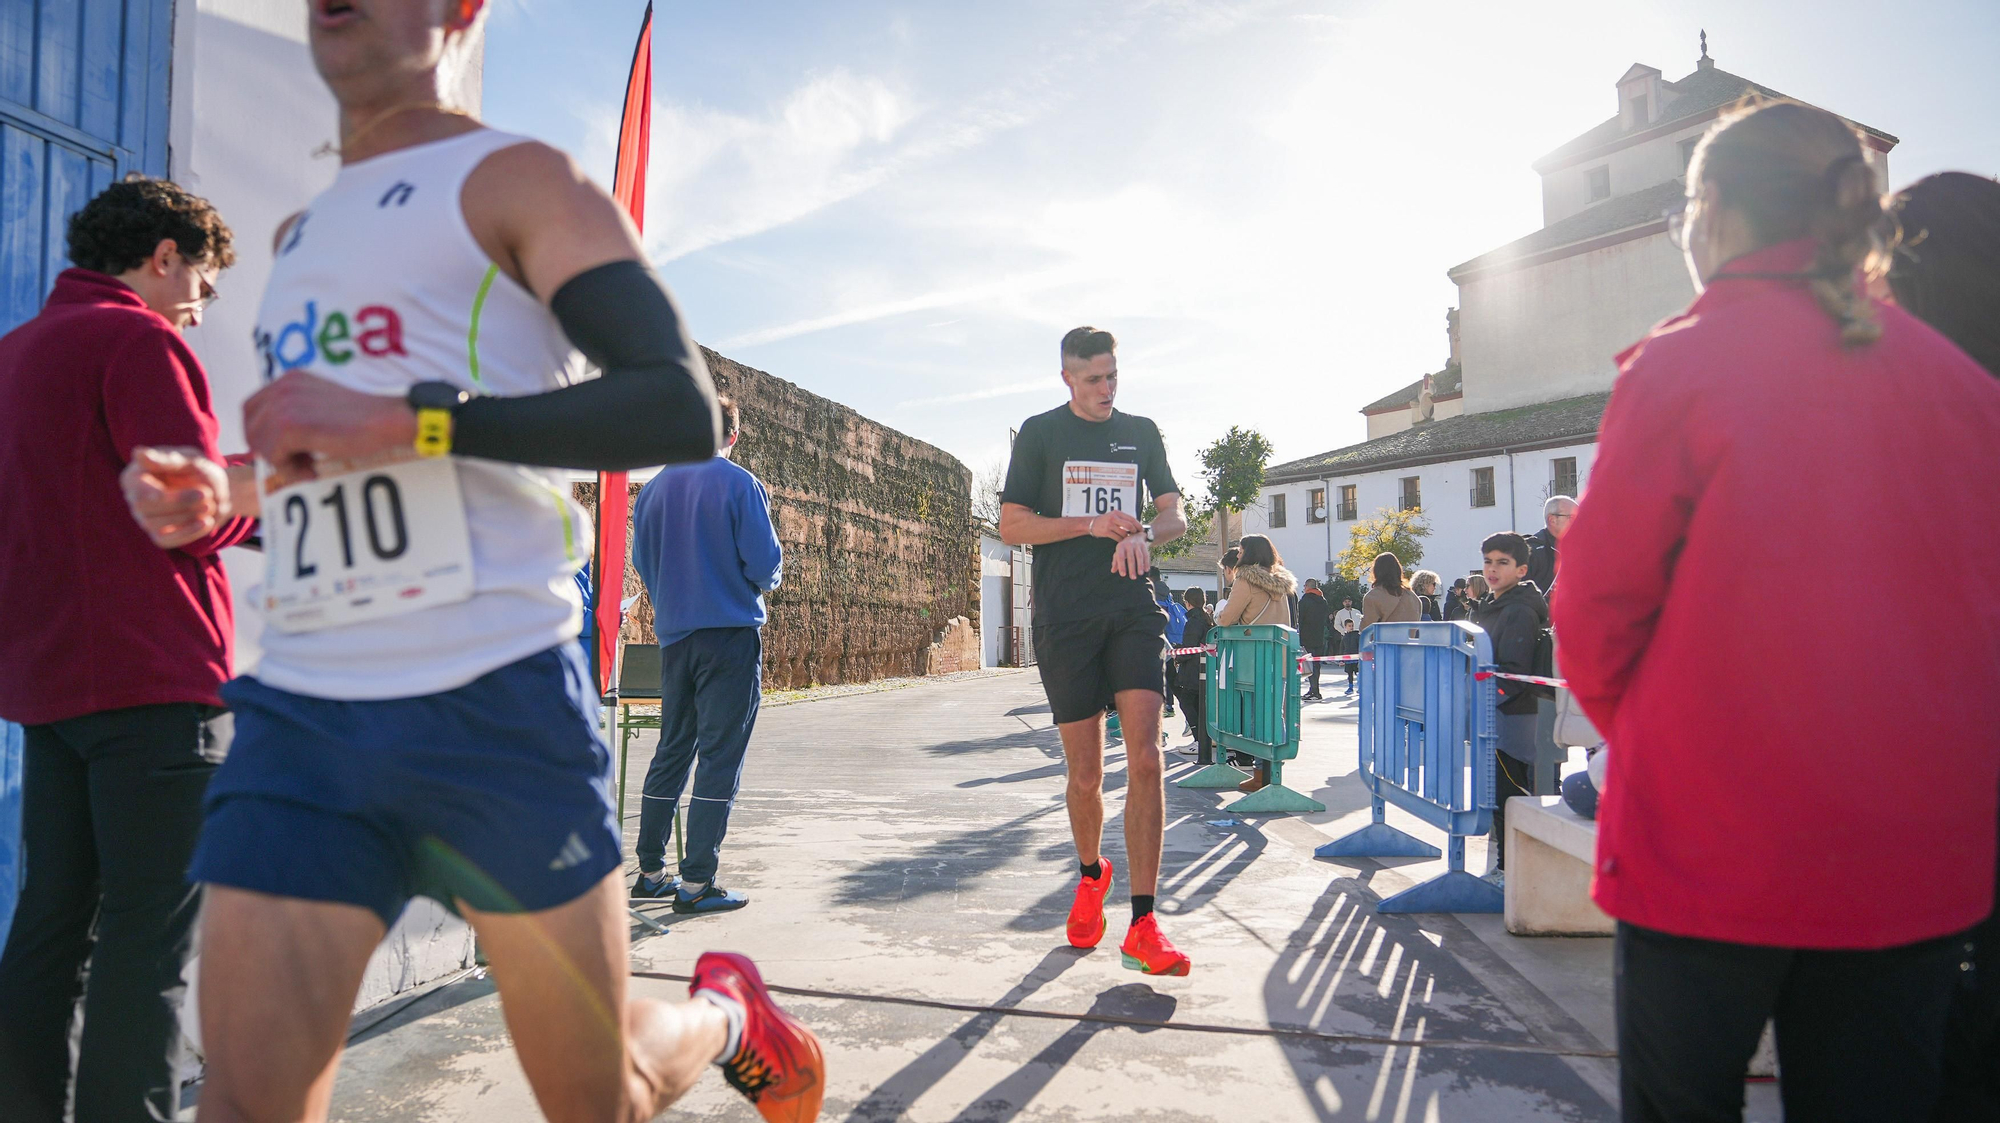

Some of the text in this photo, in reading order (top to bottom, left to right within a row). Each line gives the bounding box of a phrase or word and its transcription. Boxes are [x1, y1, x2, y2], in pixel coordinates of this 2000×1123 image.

[1067, 466, 1092, 484] XLII
[1081, 487, 1122, 515] 165
[285, 474, 408, 579] 210
